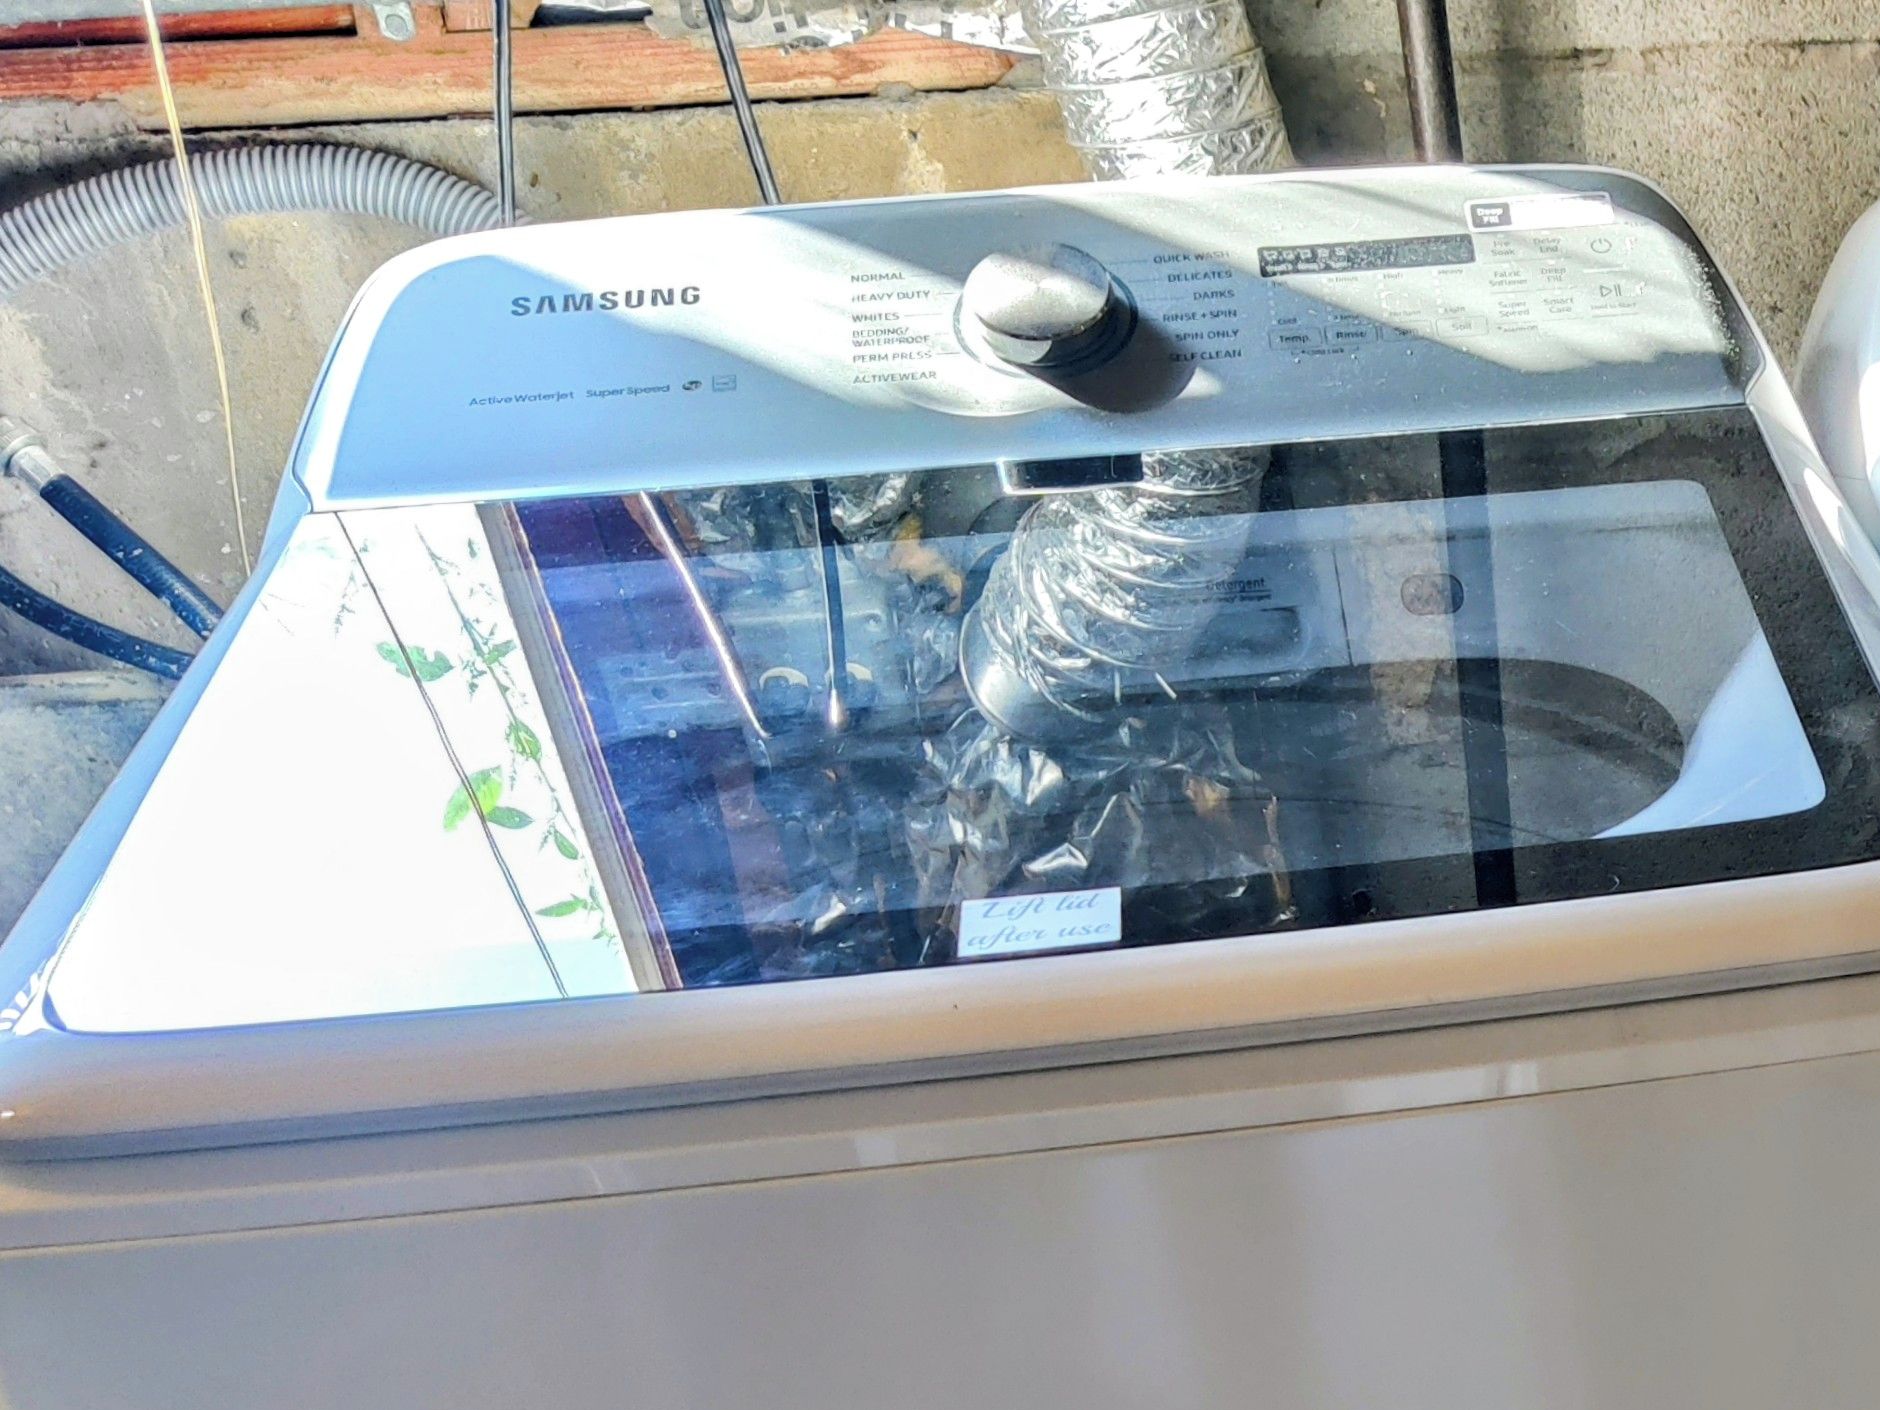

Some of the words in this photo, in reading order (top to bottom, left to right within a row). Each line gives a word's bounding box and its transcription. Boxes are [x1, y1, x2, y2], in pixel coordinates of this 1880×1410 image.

[1476, 207, 1504, 217] Deep
[1153, 253, 1191, 265] QUICK
[1195, 251, 1230, 261] WASH
[1490, 248, 1516, 256] Soak
[850, 271, 906, 283] NORMAL
[1167, 270, 1233, 283] DELICATES
[511, 285, 701, 317] SAMSUNG
[851, 291, 894, 303] HEAVY
[896, 289, 931, 300] DUTY
[1193, 289, 1235, 301] DARKS
[851, 312, 900, 323] WHITES
[1162, 312, 1199, 323] RINSE
[1209, 309, 1238, 319] SPIN
[852, 326, 910, 338] BEDDING/
[1175, 331, 1204, 342] SPIN
[1207, 328, 1240, 340] ONLY
[851, 335, 931, 348] WATERPROOF
[853, 352, 889, 363] PERM
[892, 349, 932, 361] PRESS
[1169, 351, 1199, 362] SELF
[1200, 349, 1242, 361] CLEAN
[853, 371, 937, 384] ACTIVEWEAR
[982, 897, 1045, 921] Lift
[1055, 893, 1100, 912] lid
[967, 925, 1047, 950] after
[1057, 922, 1112, 938] use
